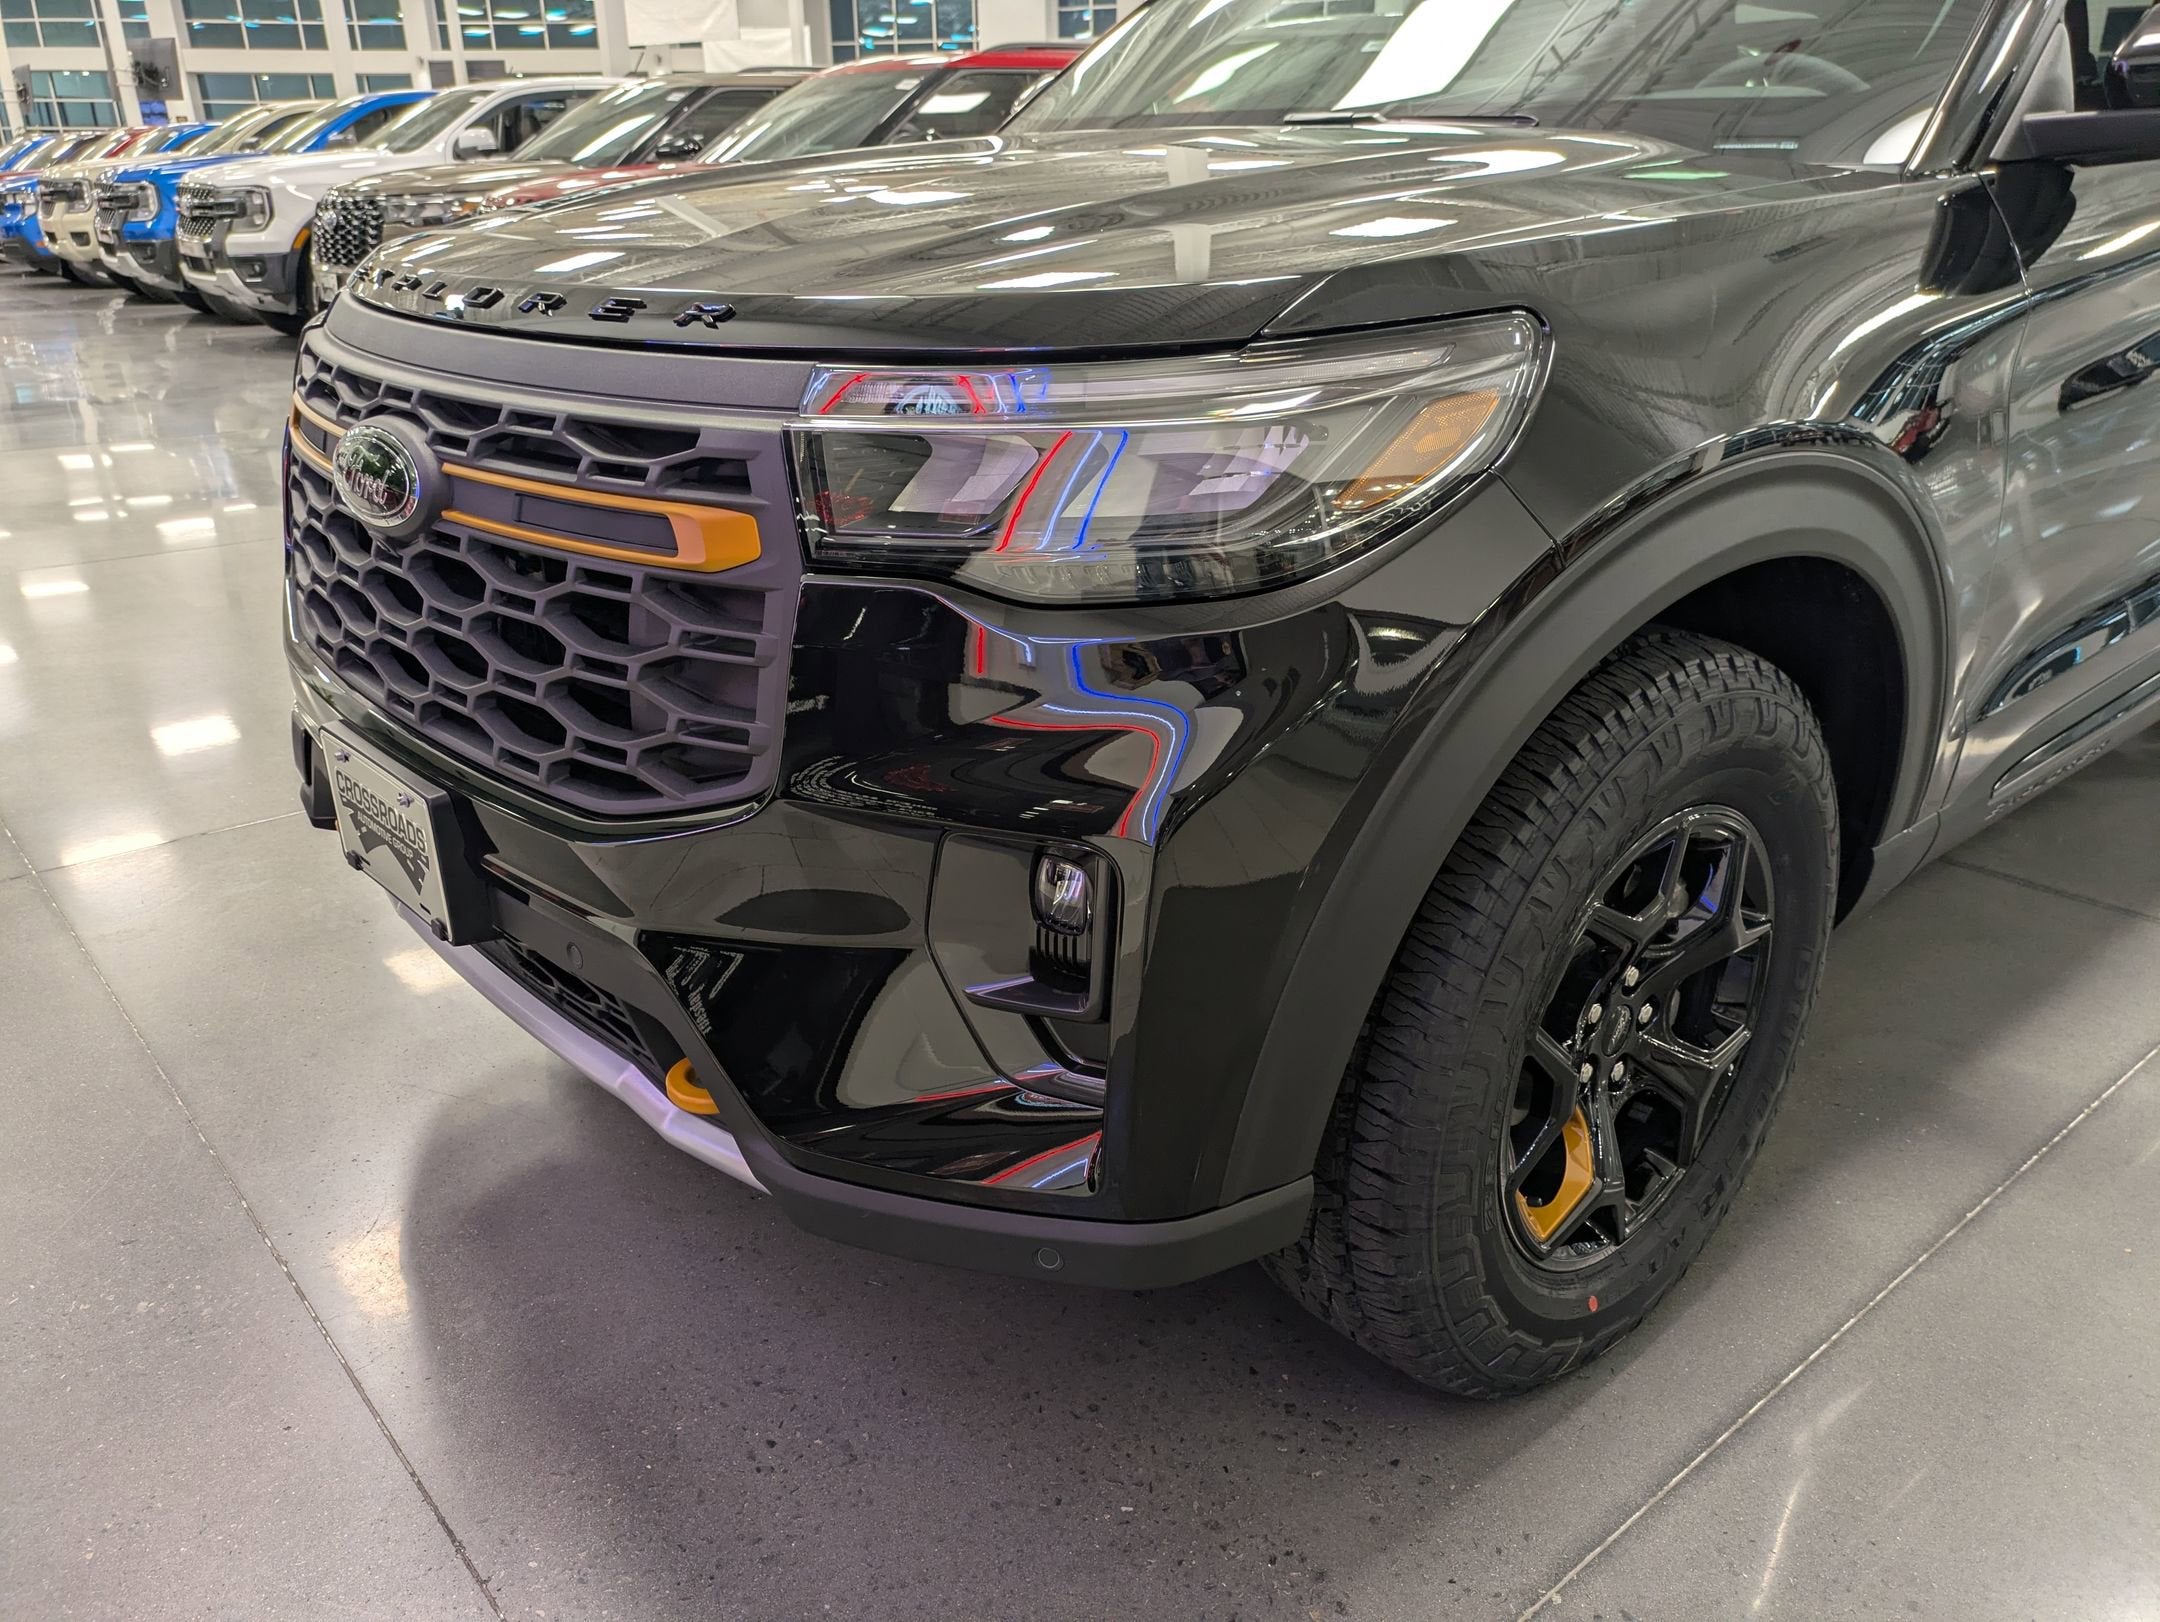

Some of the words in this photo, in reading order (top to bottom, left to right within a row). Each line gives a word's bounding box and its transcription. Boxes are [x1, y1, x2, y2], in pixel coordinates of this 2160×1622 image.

[335, 769, 427, 855] CROSSROADS
[357, 810, 393, 845] AUTOMOTIVE
[392, 837, 414, 859] GROUP
